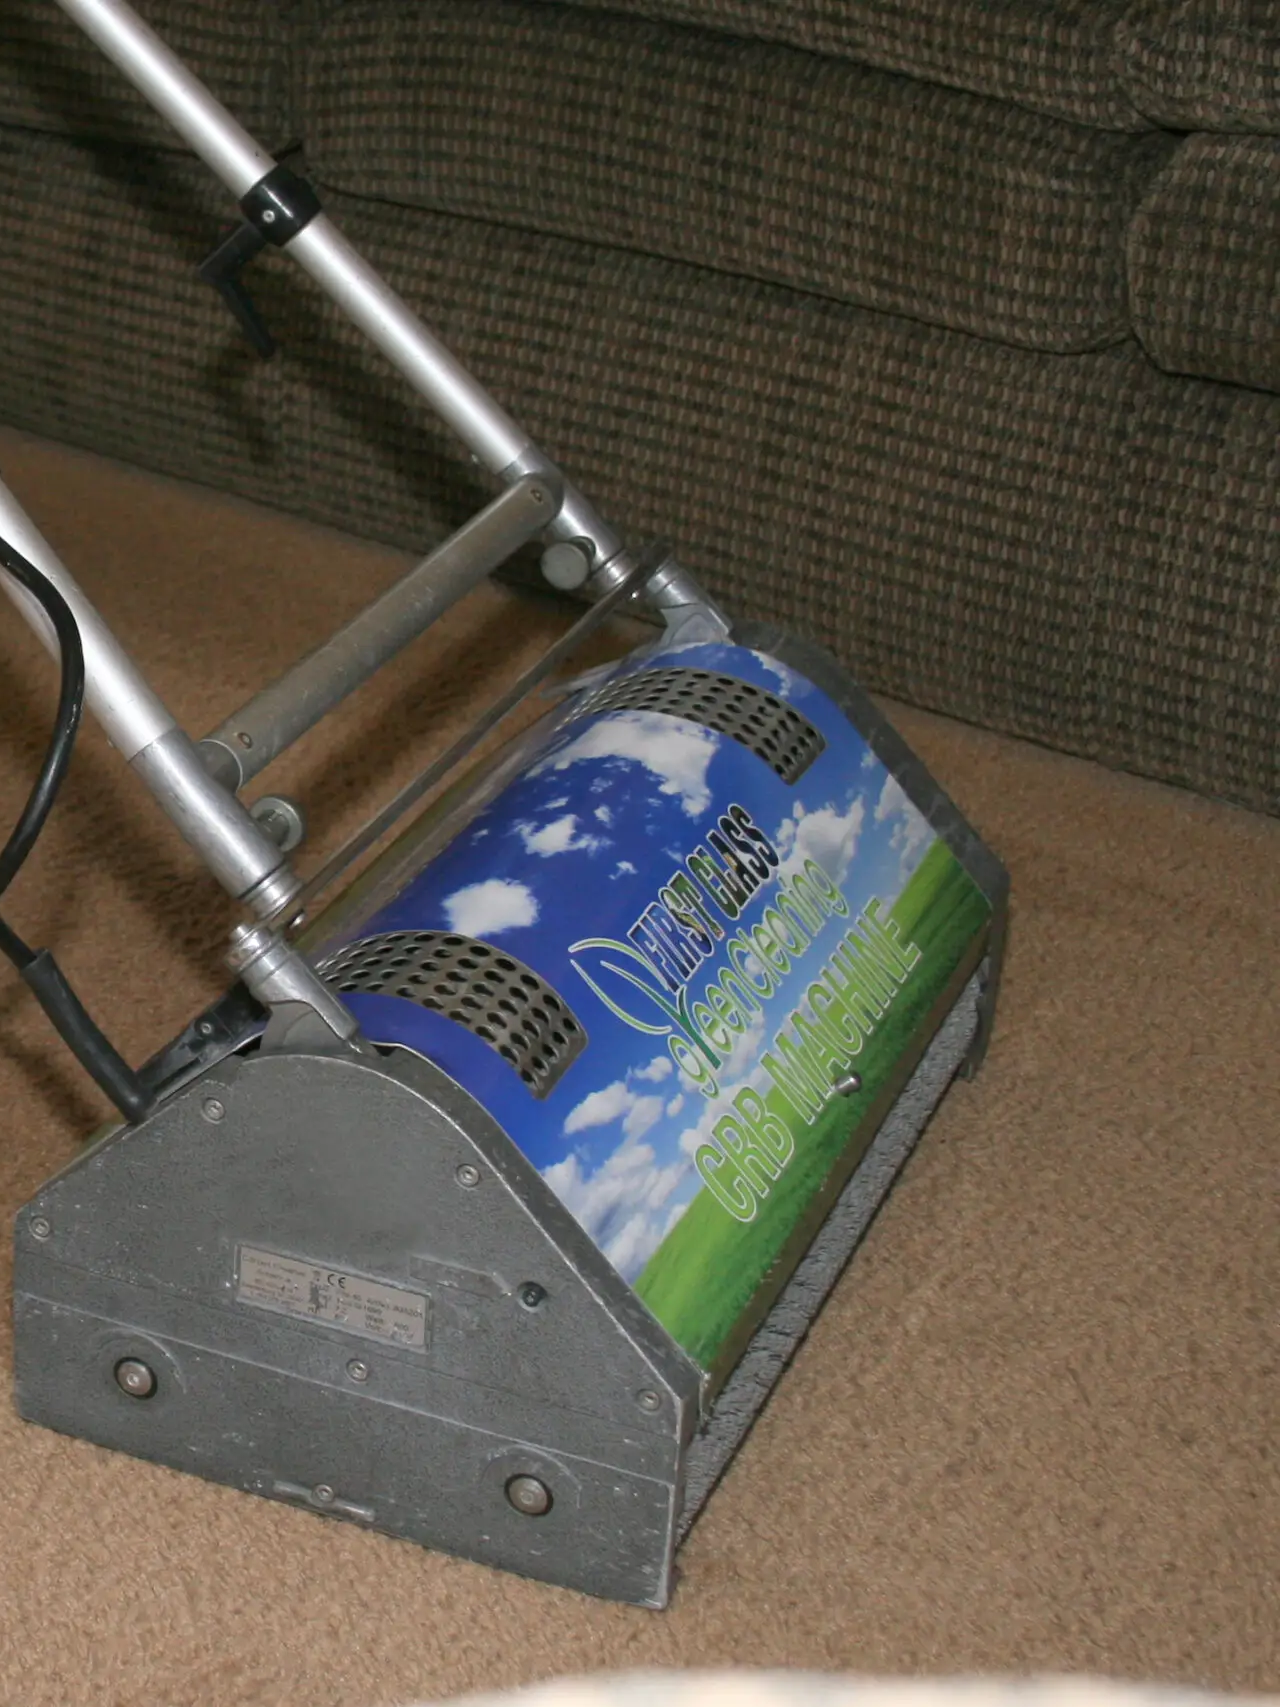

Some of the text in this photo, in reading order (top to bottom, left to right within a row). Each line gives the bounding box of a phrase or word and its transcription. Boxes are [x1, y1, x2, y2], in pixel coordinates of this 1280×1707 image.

[627, 804, 780, 994] FIRST CLASS
[694, 897, 923, 1223] CRB MACHINE
